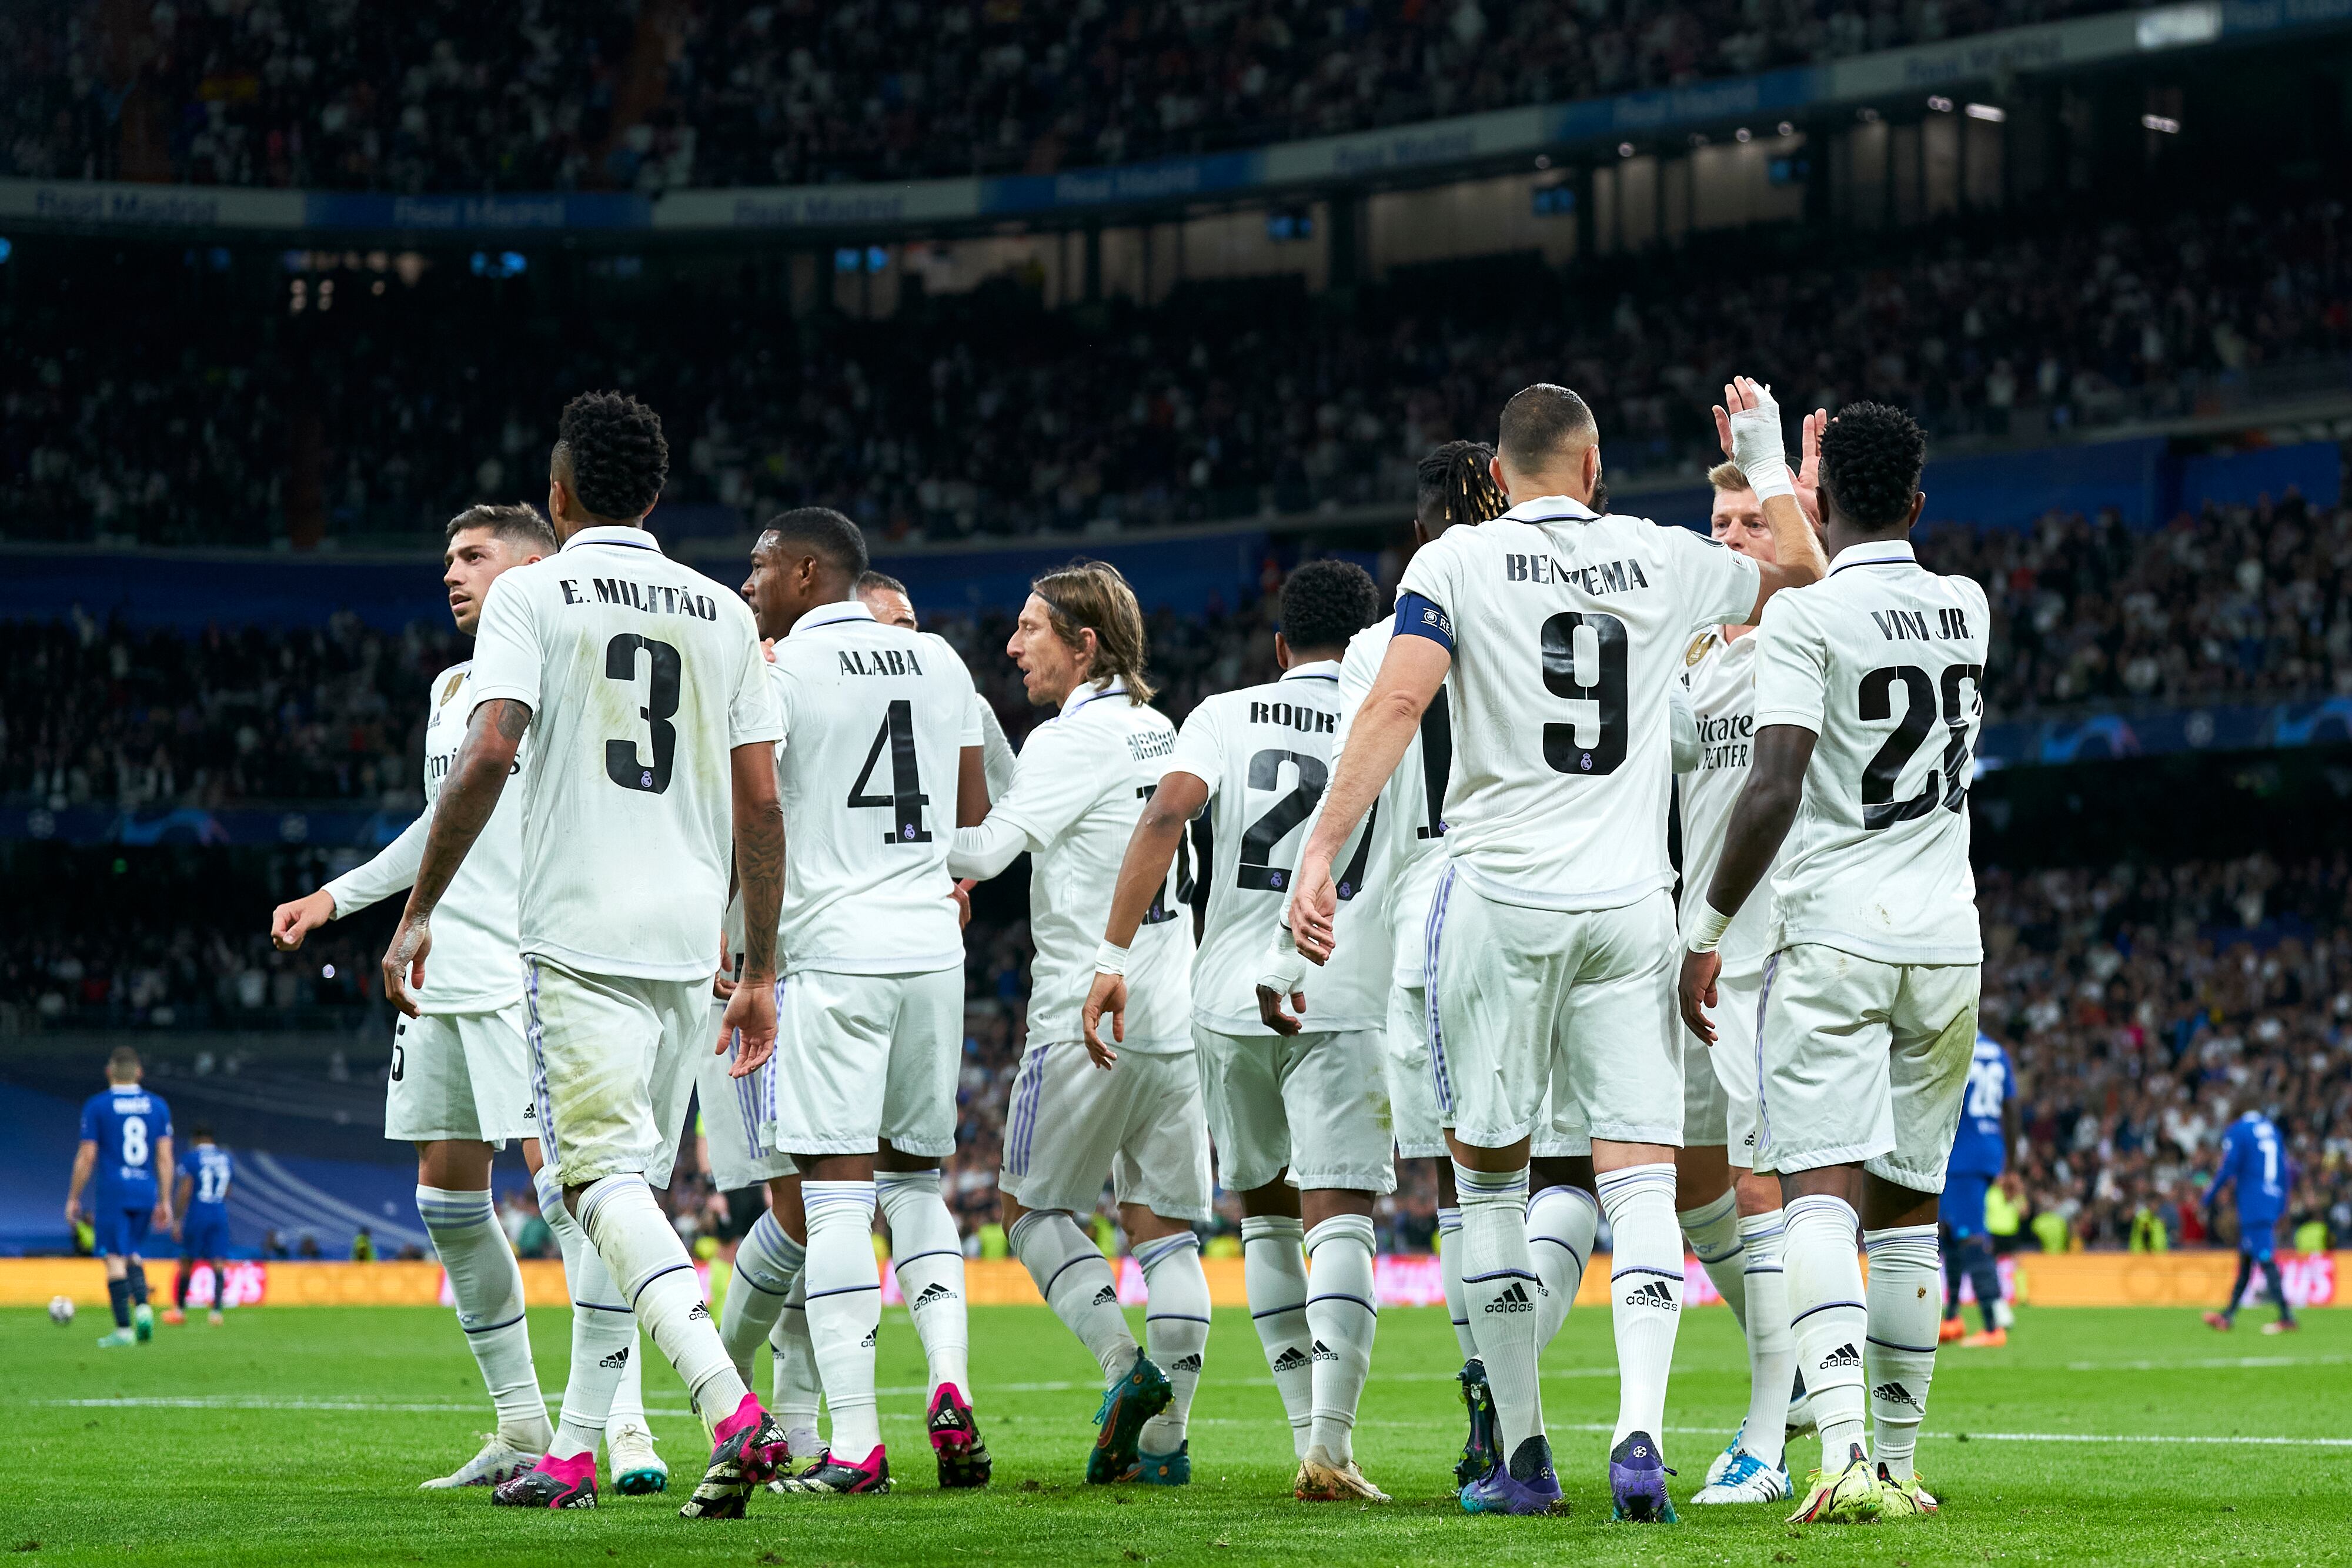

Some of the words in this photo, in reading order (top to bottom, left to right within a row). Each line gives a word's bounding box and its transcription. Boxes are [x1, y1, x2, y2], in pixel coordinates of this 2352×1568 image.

[559, 579, 590, 604] E.
[1870, 610, 1930, 641] VINI
[1935, 608, 1974, 640] JR.
[839, 650, 923, 676] ALABA
[1541, 611, 1628, 775] 9
[605, 633, 681, 795] 3
[847, 700, 933, 844] 4
[122, 1115, 148, 1167] 8
[2257, 1138, 2278, 1183] 1
[913, 1292, 958, 1311] adidas
[1485, 1301, 1534, 1313] adidas
[1626, 1294, 1678, 1312] adidas
[1273, 1356, 1313, 1372] adidas
[1819, 1358, 1863, 1370] adidas
[1873, 1389, 1917, 1405] adidas
